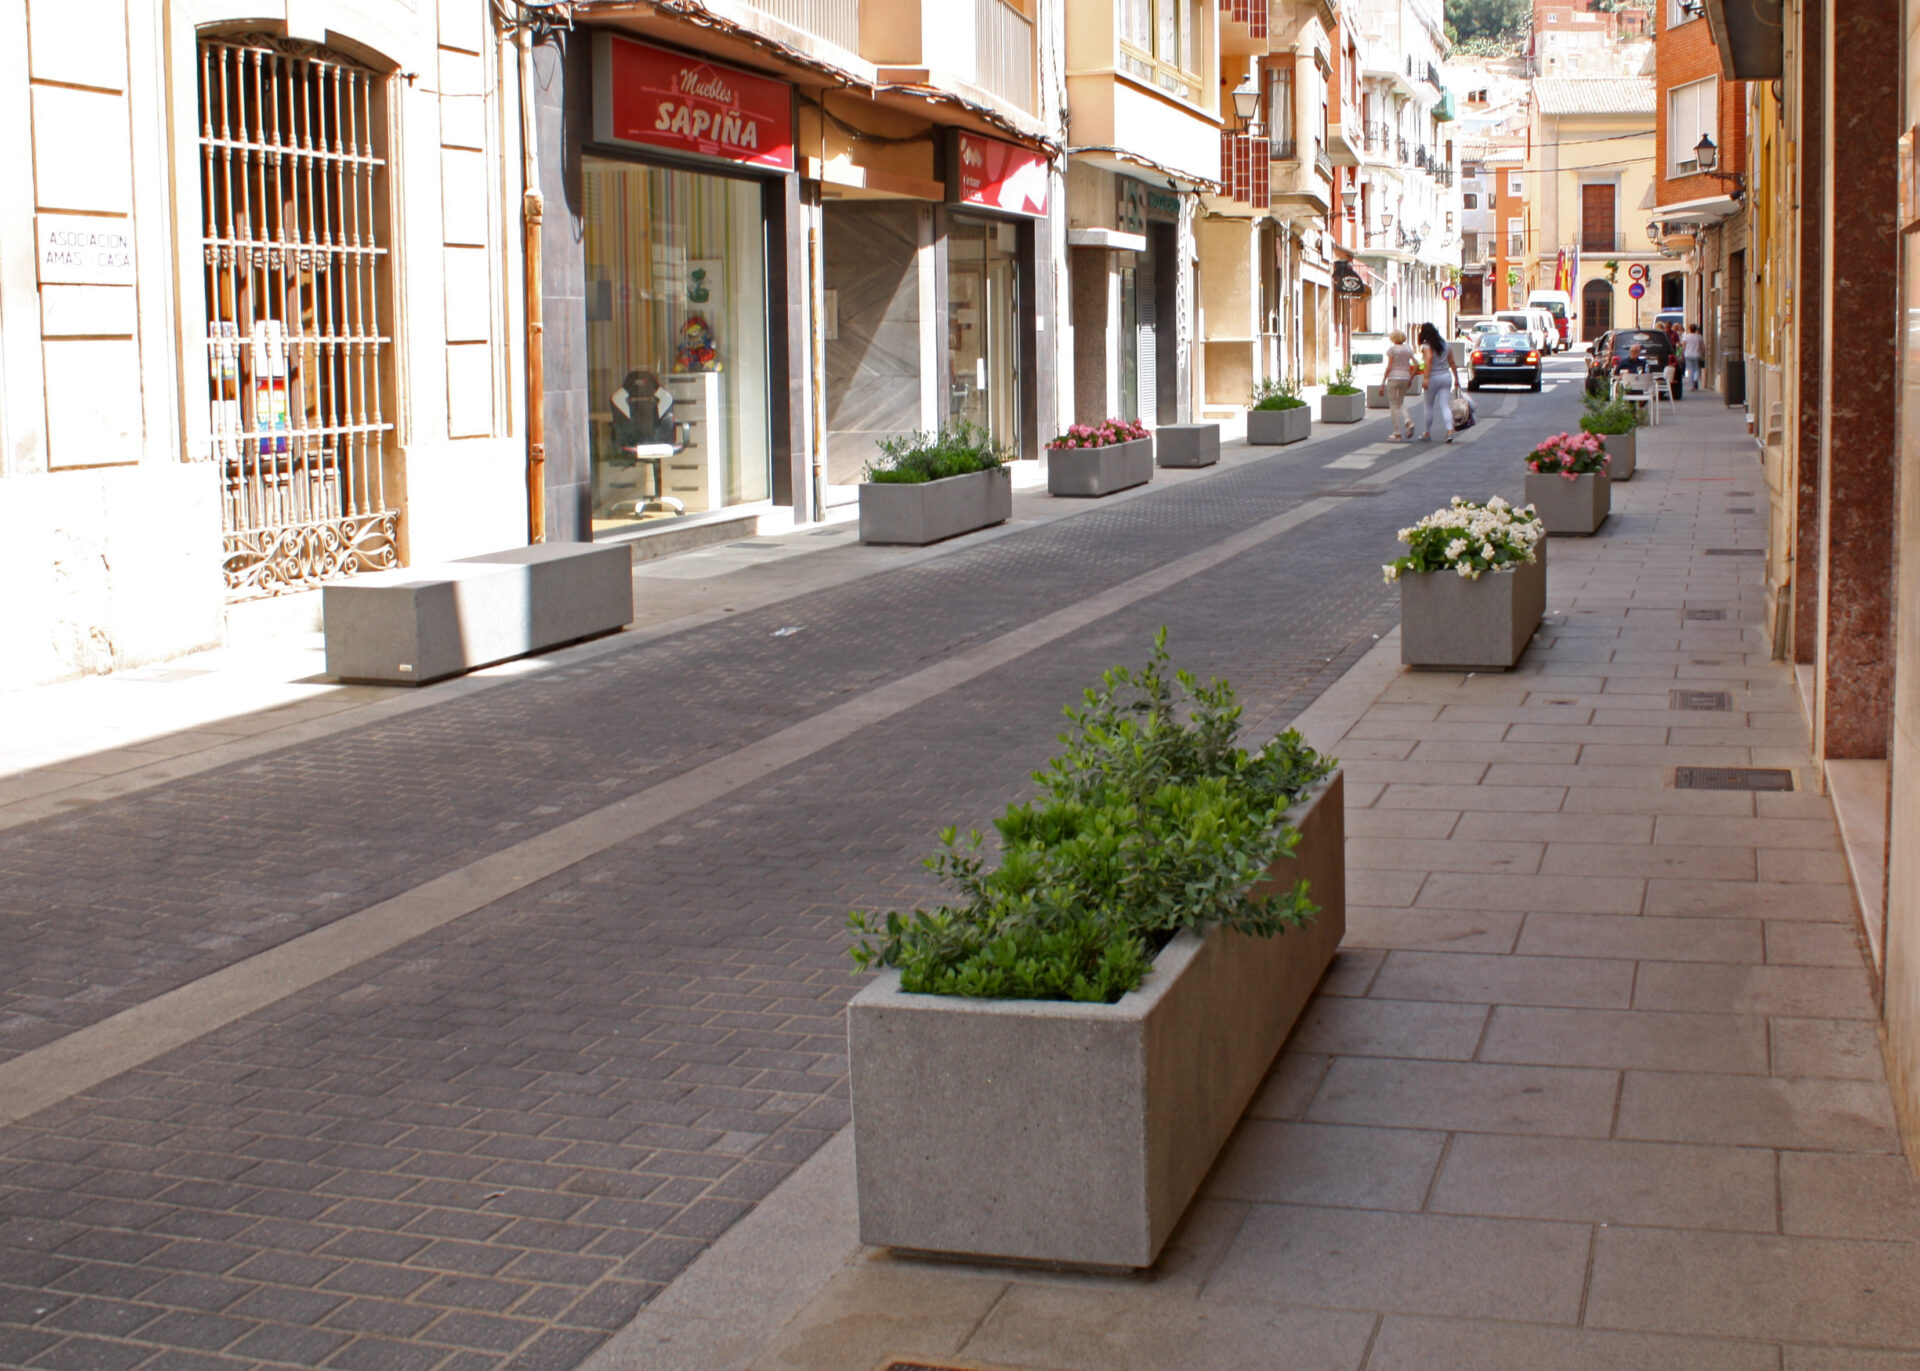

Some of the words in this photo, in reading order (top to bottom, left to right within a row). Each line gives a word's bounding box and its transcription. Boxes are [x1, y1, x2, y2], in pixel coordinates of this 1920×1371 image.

[680, 69, 732, 103] Muebles
[655, 102, 757, 149] SAPIÑA
[49, 231, 127, 249] ASOCIACION
[46, 250, 83, 267] AMAS
[97, 252, 131, 267] CASA
